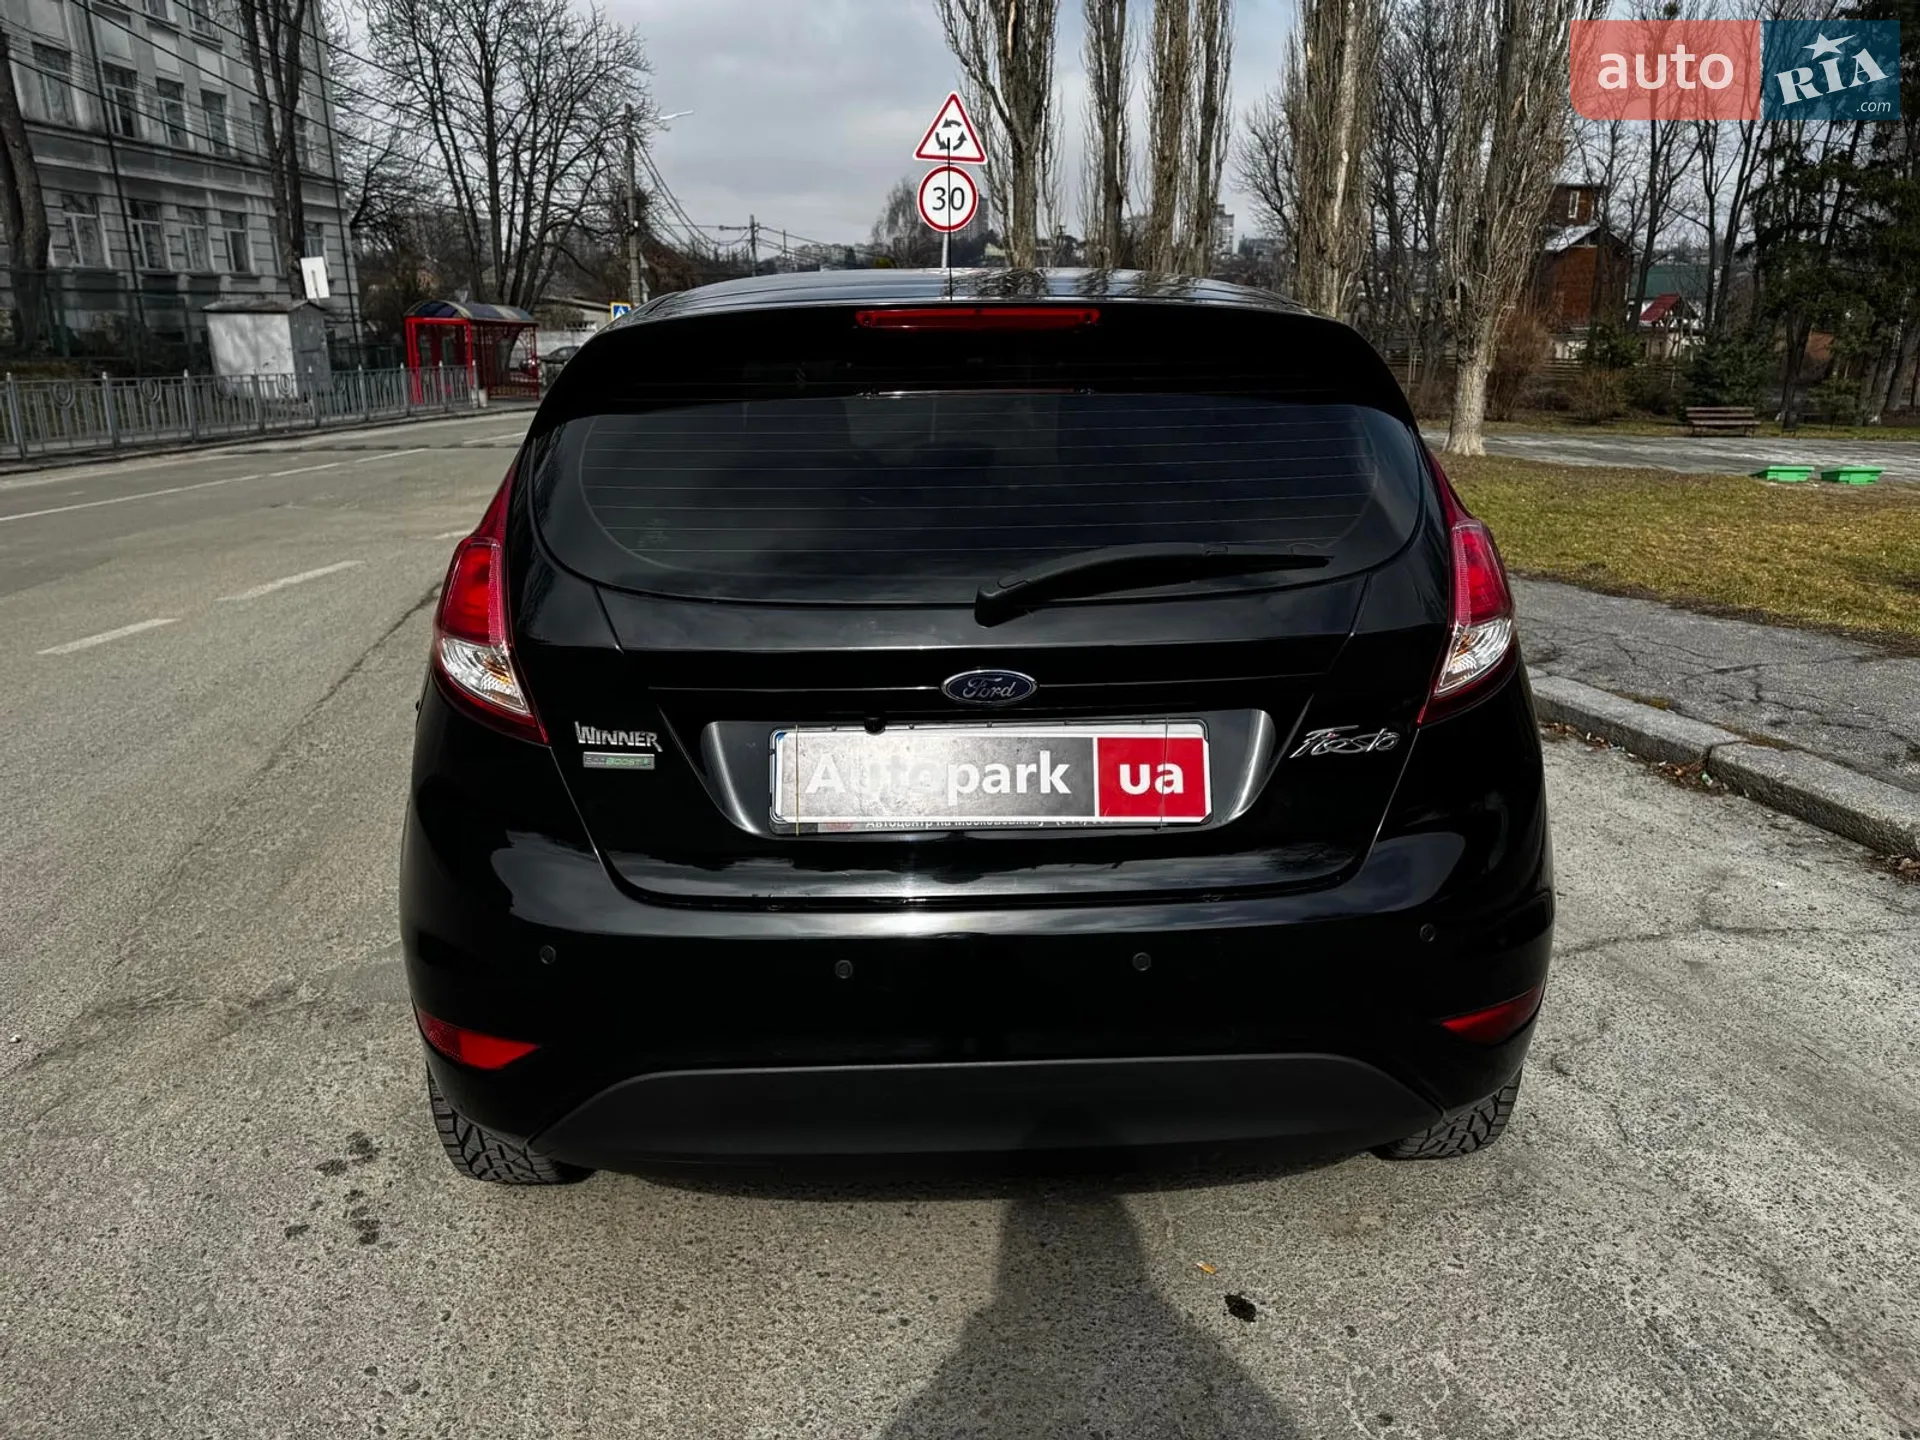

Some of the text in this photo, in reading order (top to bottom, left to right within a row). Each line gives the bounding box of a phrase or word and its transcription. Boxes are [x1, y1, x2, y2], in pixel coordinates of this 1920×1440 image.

[932, 187, 965, 211] 30
[962, 677, 1017, 698] Ford
[574, 721, 663, 752] WINNER
[1289, 725, 1400, 758] Fiesta
[805, 750, 1184, 806] Autopark ua
